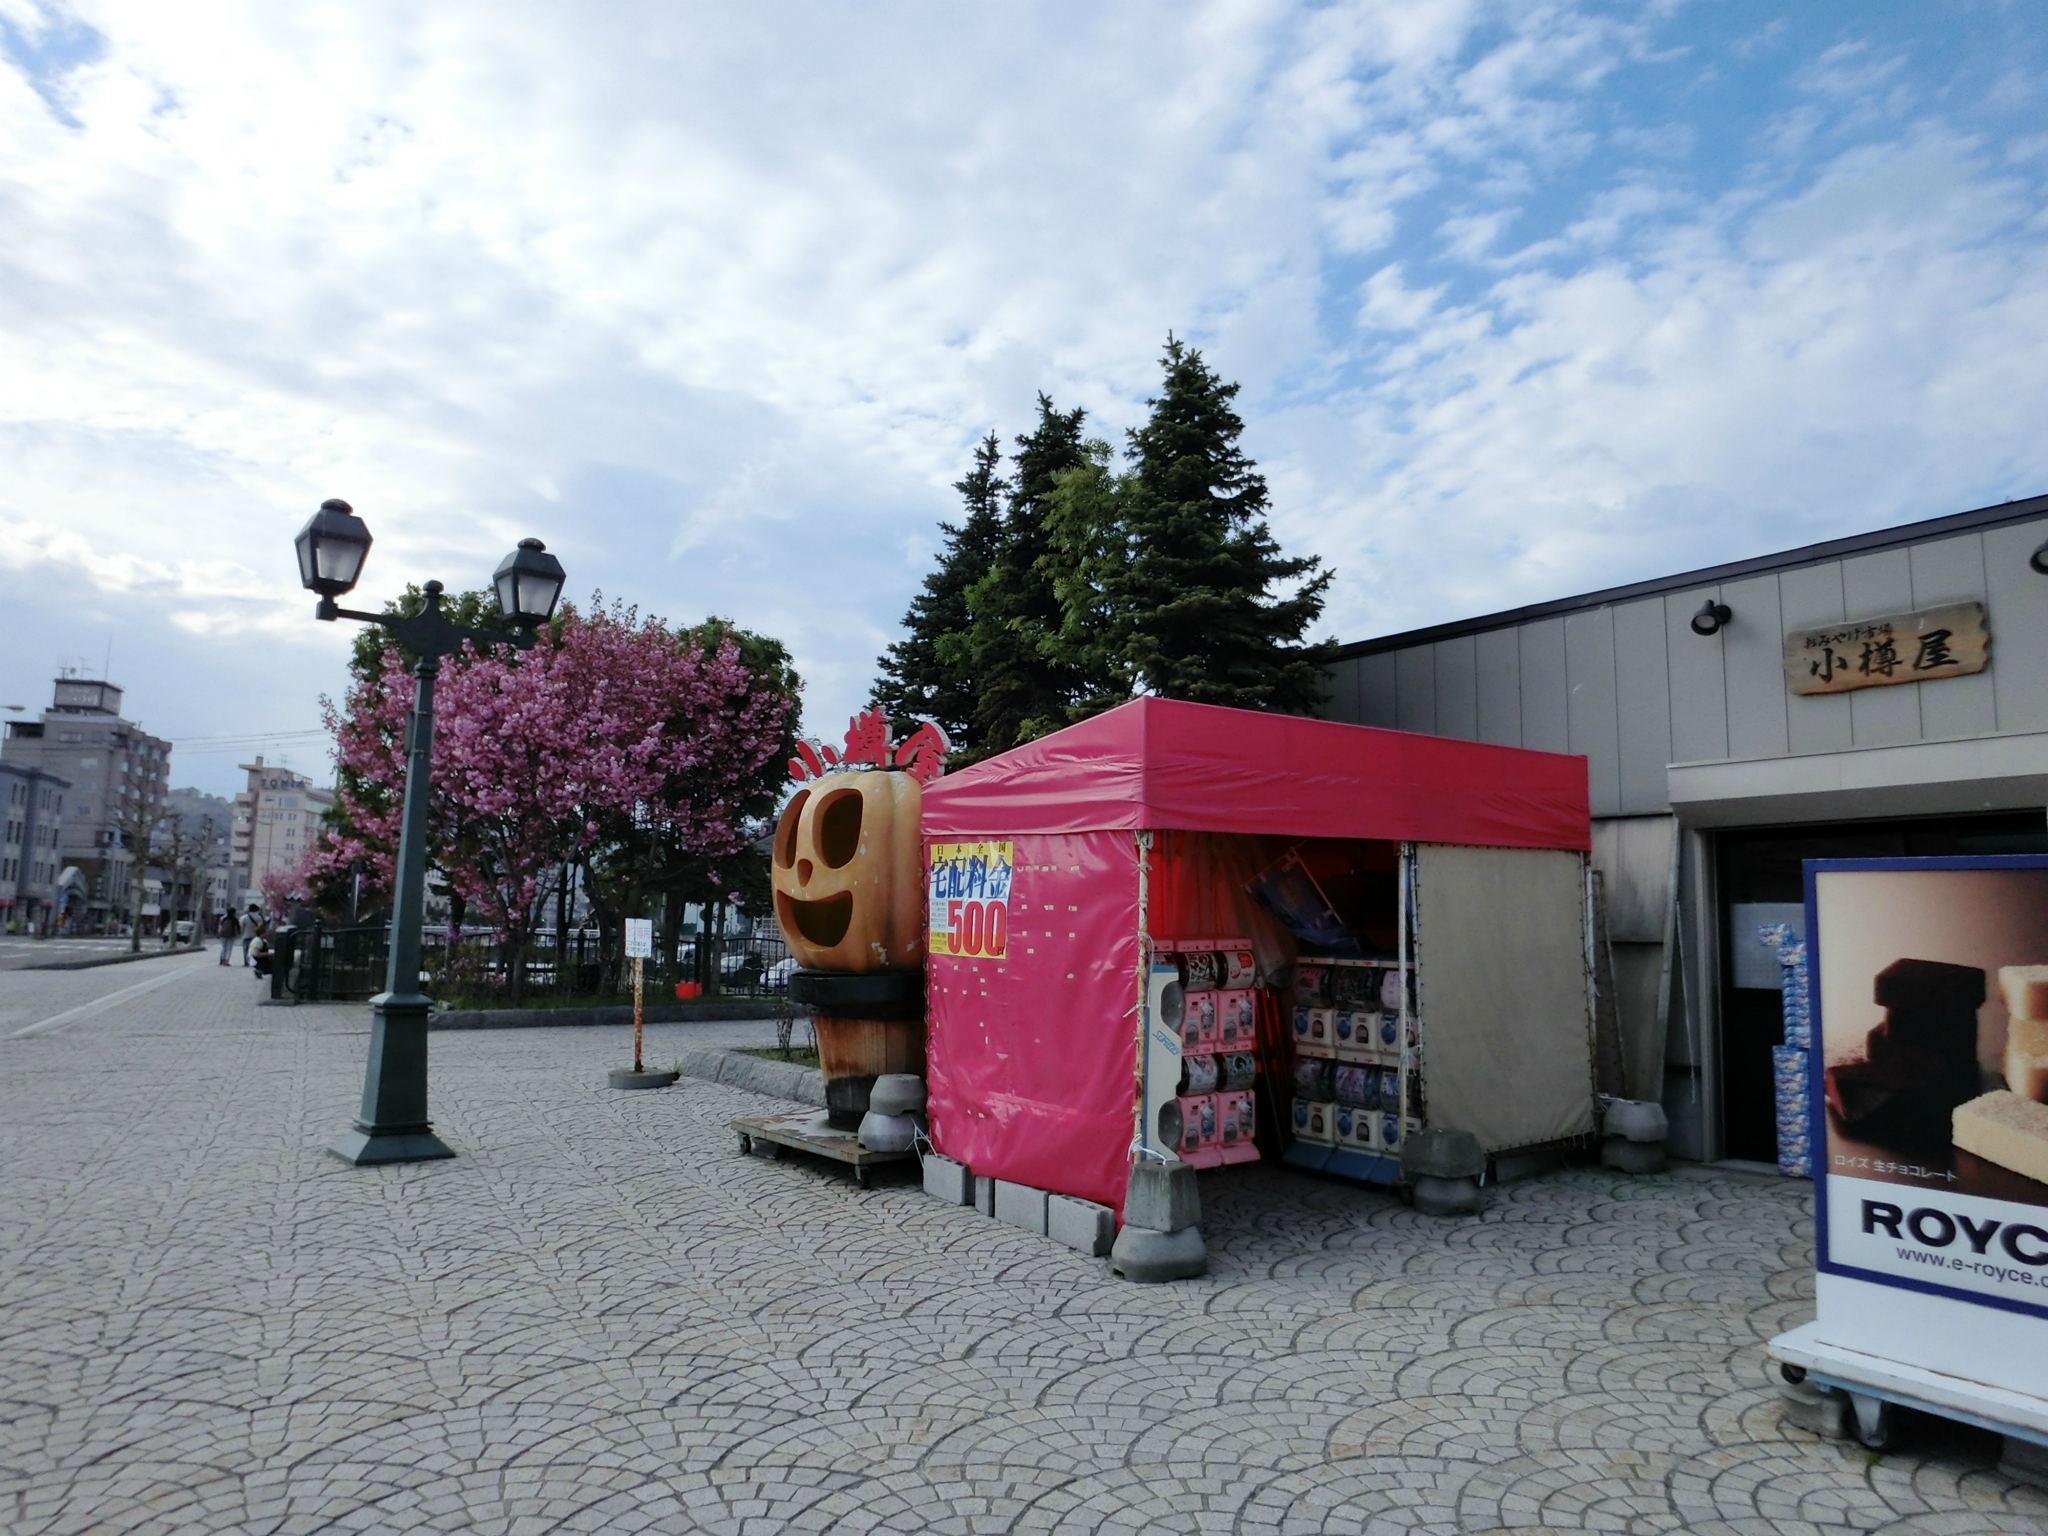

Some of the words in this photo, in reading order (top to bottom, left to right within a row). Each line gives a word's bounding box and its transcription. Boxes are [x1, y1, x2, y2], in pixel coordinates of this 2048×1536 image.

[1810, 629, 1959, 683] 小樽屋
[937, 842, 1006, 855] 日本全国
[930, 854, 1012, 899] 宅配料金
[1834, 1155, 1869, 1169] ロイズ
[1873, 1160, 1958, 1182] 生チョコレート
[1861, 1198, 2048, 1266] ROYC
